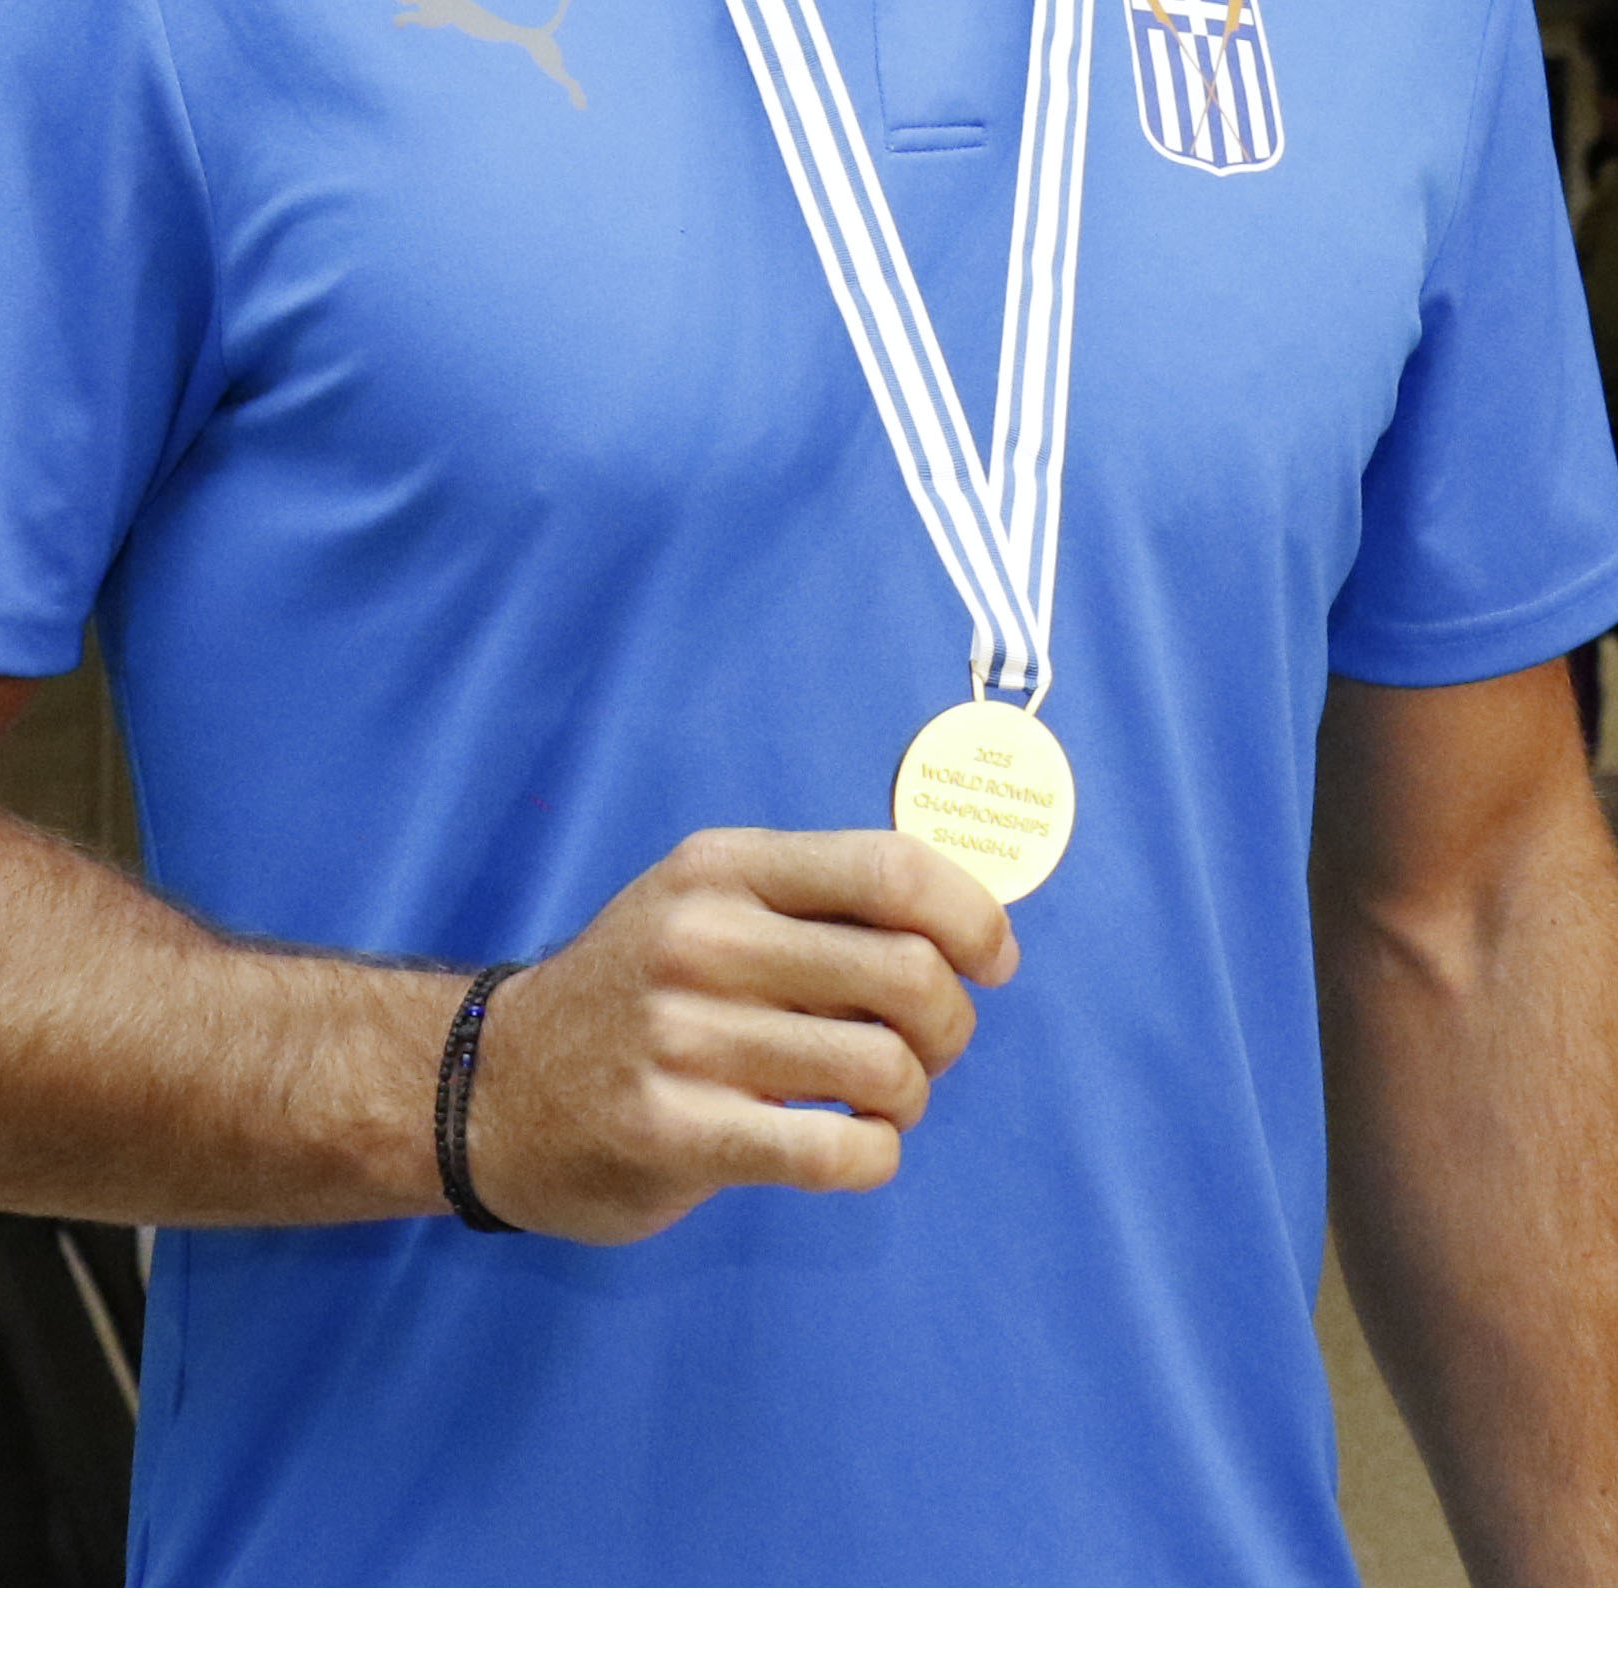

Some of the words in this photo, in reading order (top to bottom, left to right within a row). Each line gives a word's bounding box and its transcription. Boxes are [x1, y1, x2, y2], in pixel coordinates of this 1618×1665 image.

[974, 747, 1015, 769] 2025
[921, 763, 983, 792] WORLD
[985, 778, 1054, 809] ROWING
[913, 791, 1050, 837] CHAMPIONSHIPS
[932, 827, 1022, 861] SHANGHAI
